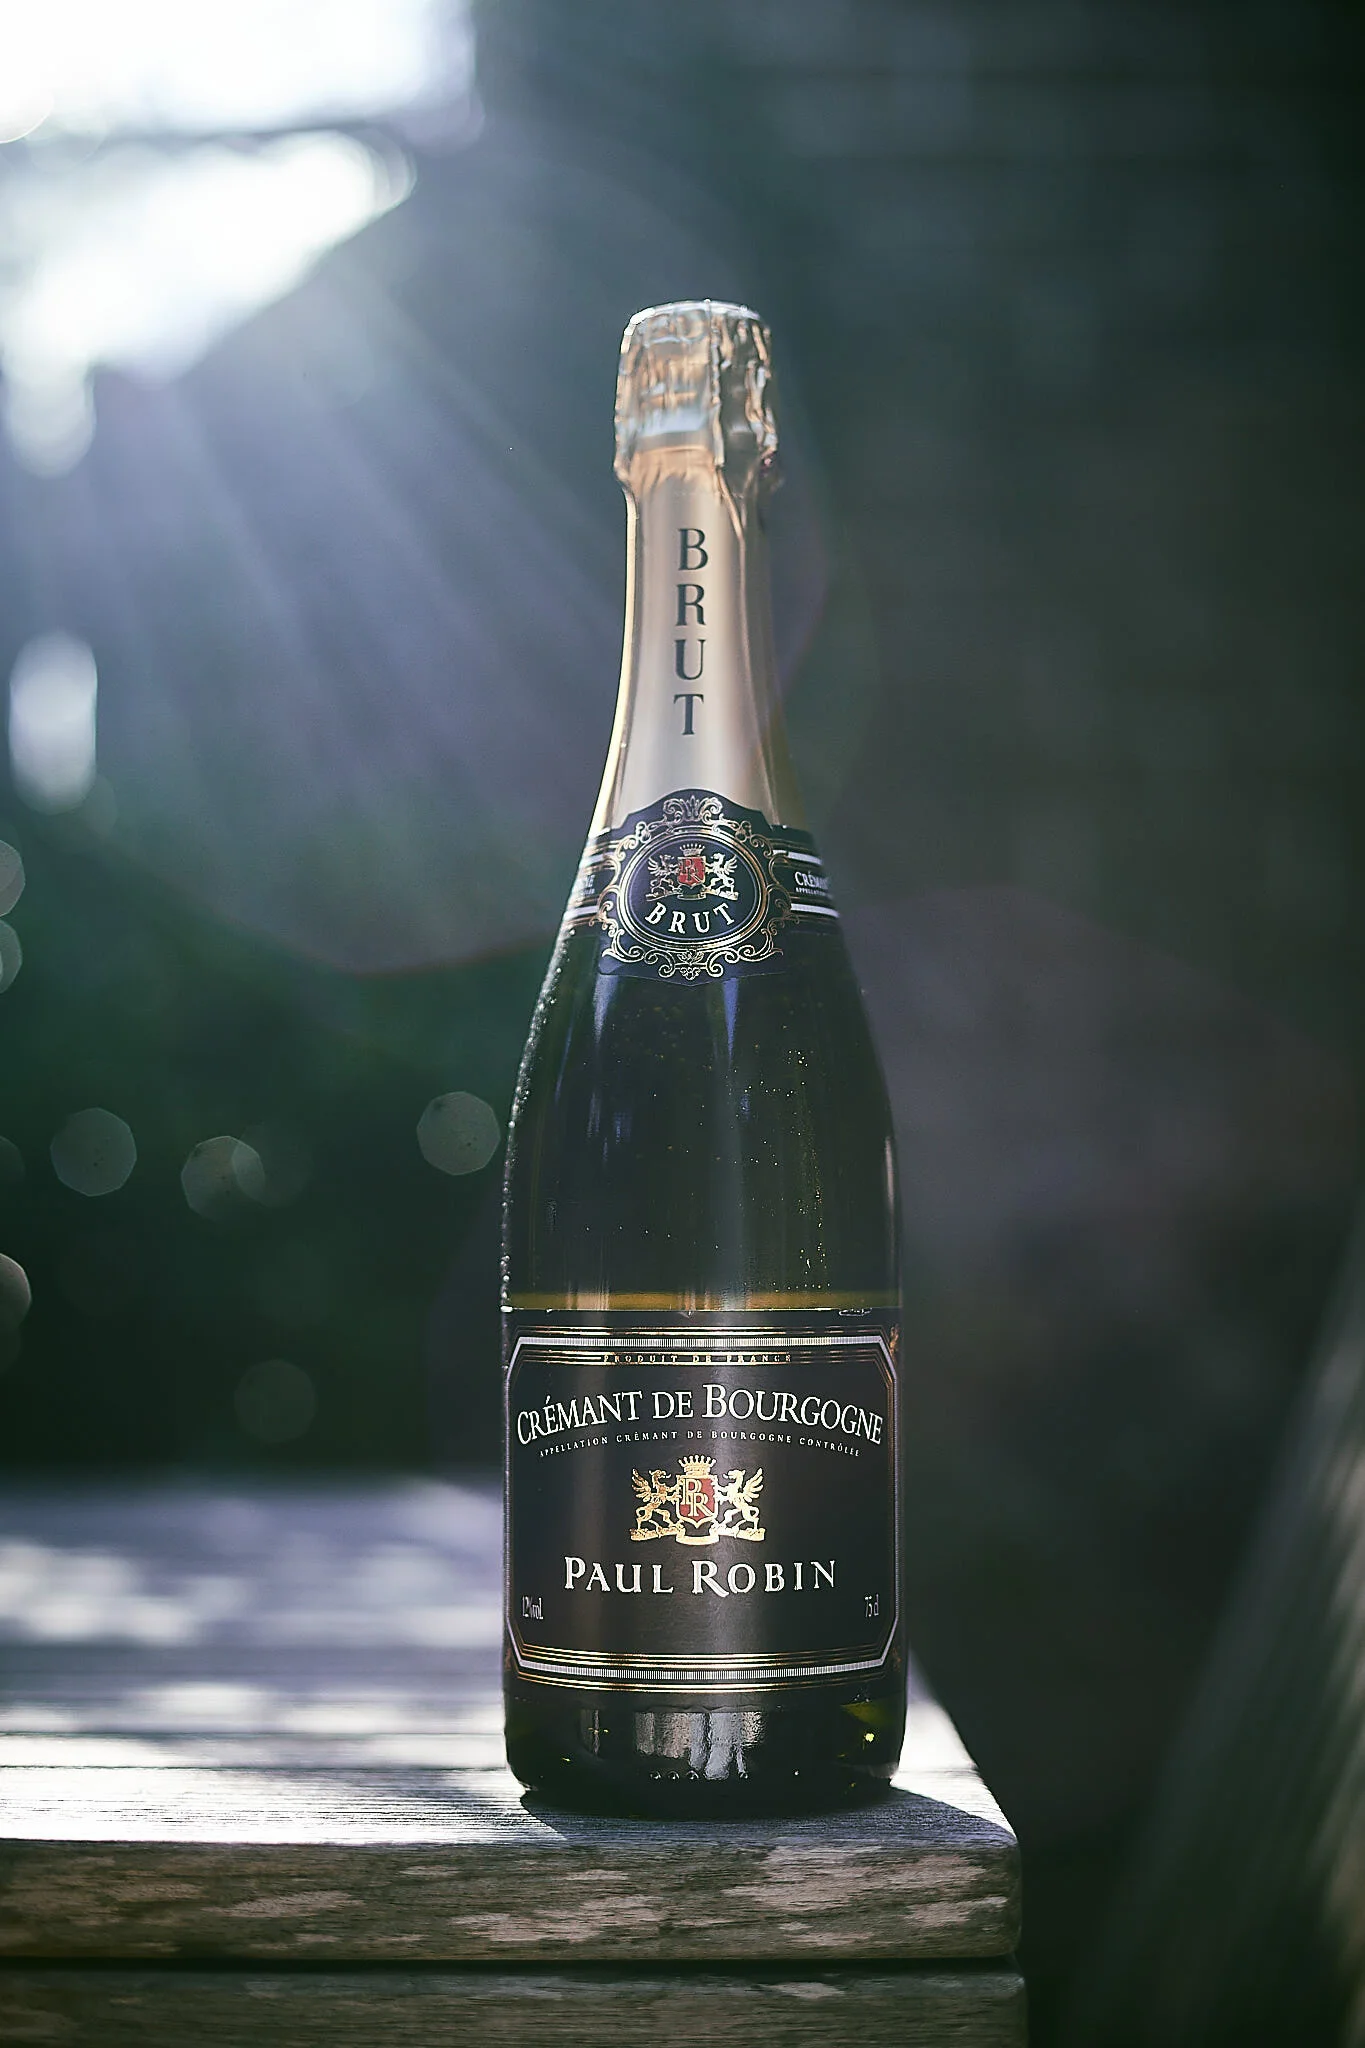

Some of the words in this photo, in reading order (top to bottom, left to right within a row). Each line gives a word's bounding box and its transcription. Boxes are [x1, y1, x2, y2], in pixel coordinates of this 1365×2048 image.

[673, 528, 709, 735] BRUT
[644, 902, 736, 934] BRUT
[692, 1355, 712, 1363] DE
[516, 1390, 643, 1446] CRÉMANT
[651, 1391, 694, 1419] DE
[701, 1384, 884, 1446] BOURGOGNE
[539, 1436, 608, 1457] APPELLATION
[616, 1431, 678, 1443] CRÉMANT
[687, 1430, 703, 1439] DE
[711, 1431, 792, 1443] BOURGOGNE
[564, 1556, 673, 1594] PAUL
[691, 1560, 837, 1598] ROBIN
